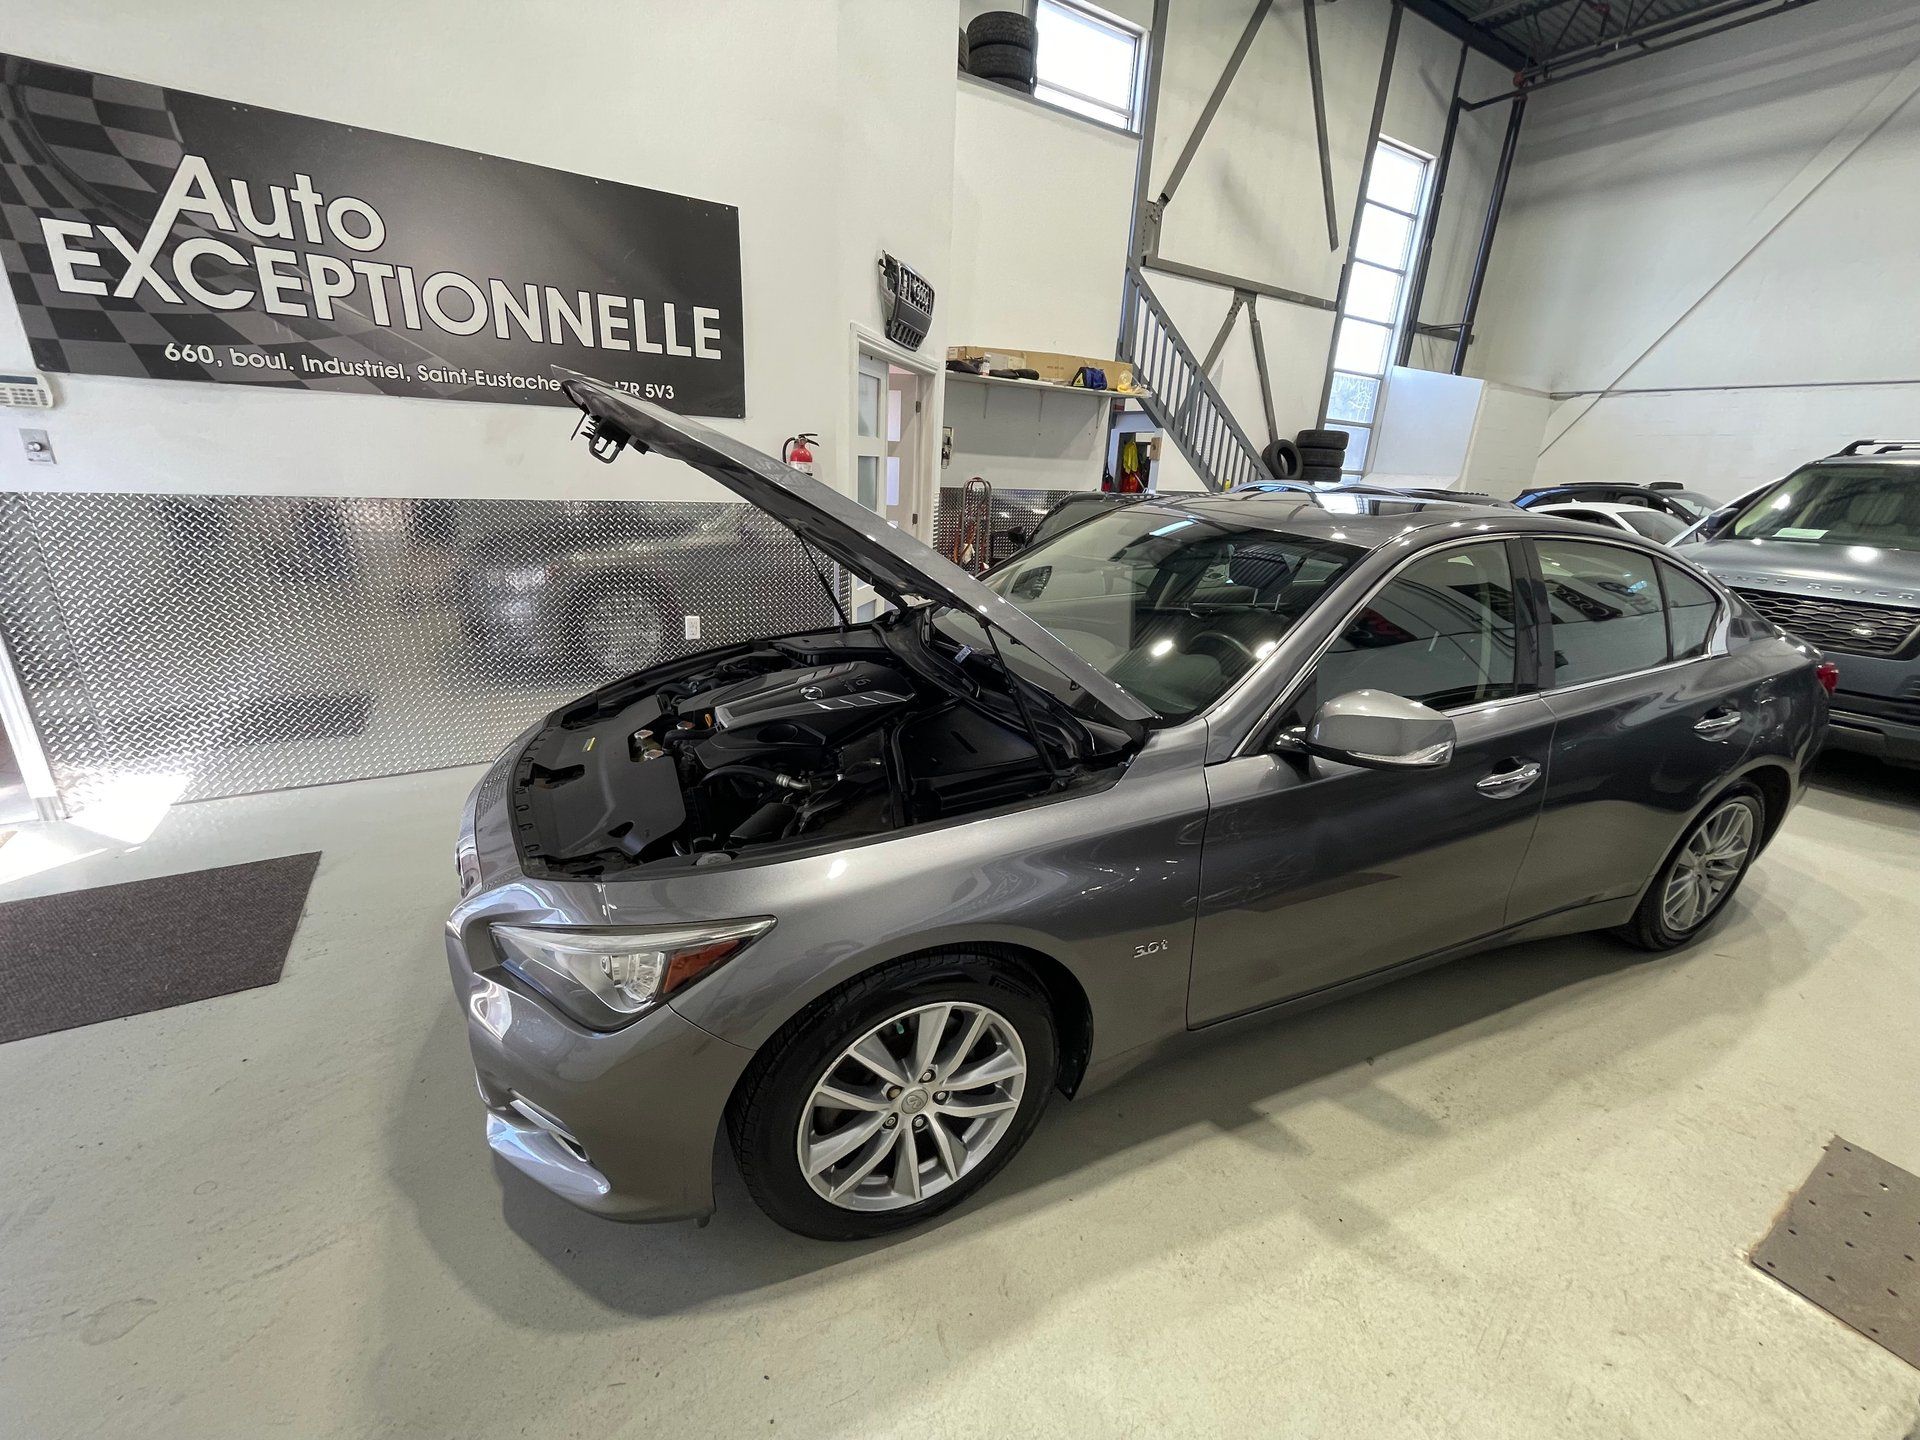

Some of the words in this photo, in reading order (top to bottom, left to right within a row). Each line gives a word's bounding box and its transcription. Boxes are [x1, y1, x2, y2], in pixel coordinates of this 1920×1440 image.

[39, 216, 722, 360] EXCEPTIONNELLE
[112, 153, 386, 298] Auto
[164, 342, 223, 368] 660,
[228, 347, 295, 372] boul.
[301, 353, 411, 383] Industriel,
[417, 363, 562, 392] Saint-Eustache
[645, 384, 675, 400] 5V3
